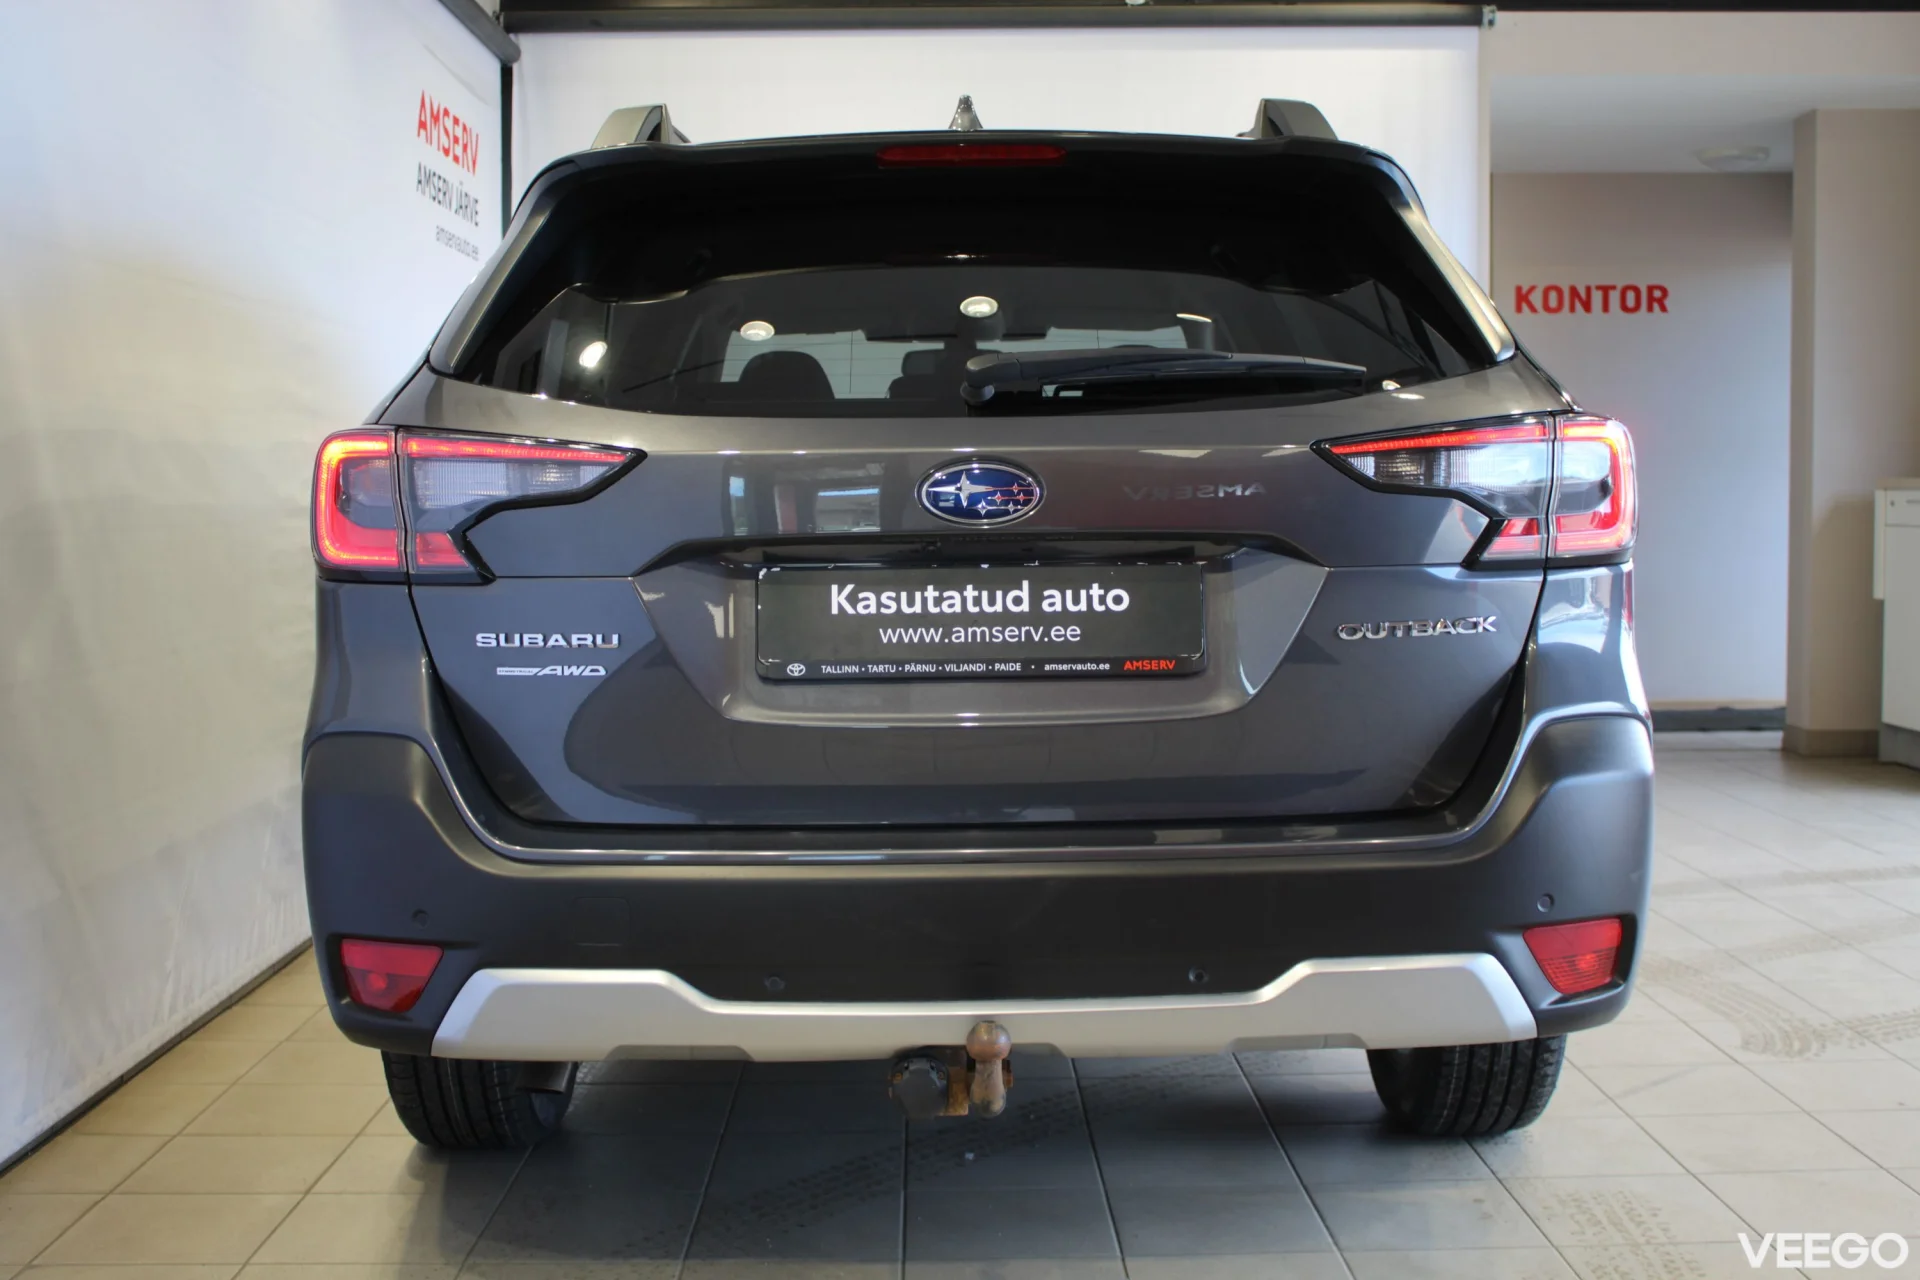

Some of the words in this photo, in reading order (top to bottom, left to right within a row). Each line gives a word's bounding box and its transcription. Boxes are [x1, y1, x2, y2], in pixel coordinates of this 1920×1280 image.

[417, 89, 479, 176] AMSERV
[416, 161, 454, 212] AMSERV
[454, 180, 479, 227] JÄRVE
[1515, 284, 1669, 314] KONTOR
[830, 580, 1030, 615] Kasutatud
[1042, 583, 1131, 612] auto
[475, 632, 620, 649] SUBARU
[879, 623, 1082, 644] www.amserv.ee
[1336, 615, 1498, 641] OUTBACK
[536, 665, 607, 676] AWD
[821, 664, 859, 674] TALLINN
[867, 664, 896, 673] TARTU
[904, 662, 936, 673] PÄRNU
[944, 663, 986, 673] VILJANDI
[994, 663, 1021, 672] PAIDE
[1044, 662, 1110, 671] amservauto.ee
[1124, 660, 1176, 671] AMSERV
